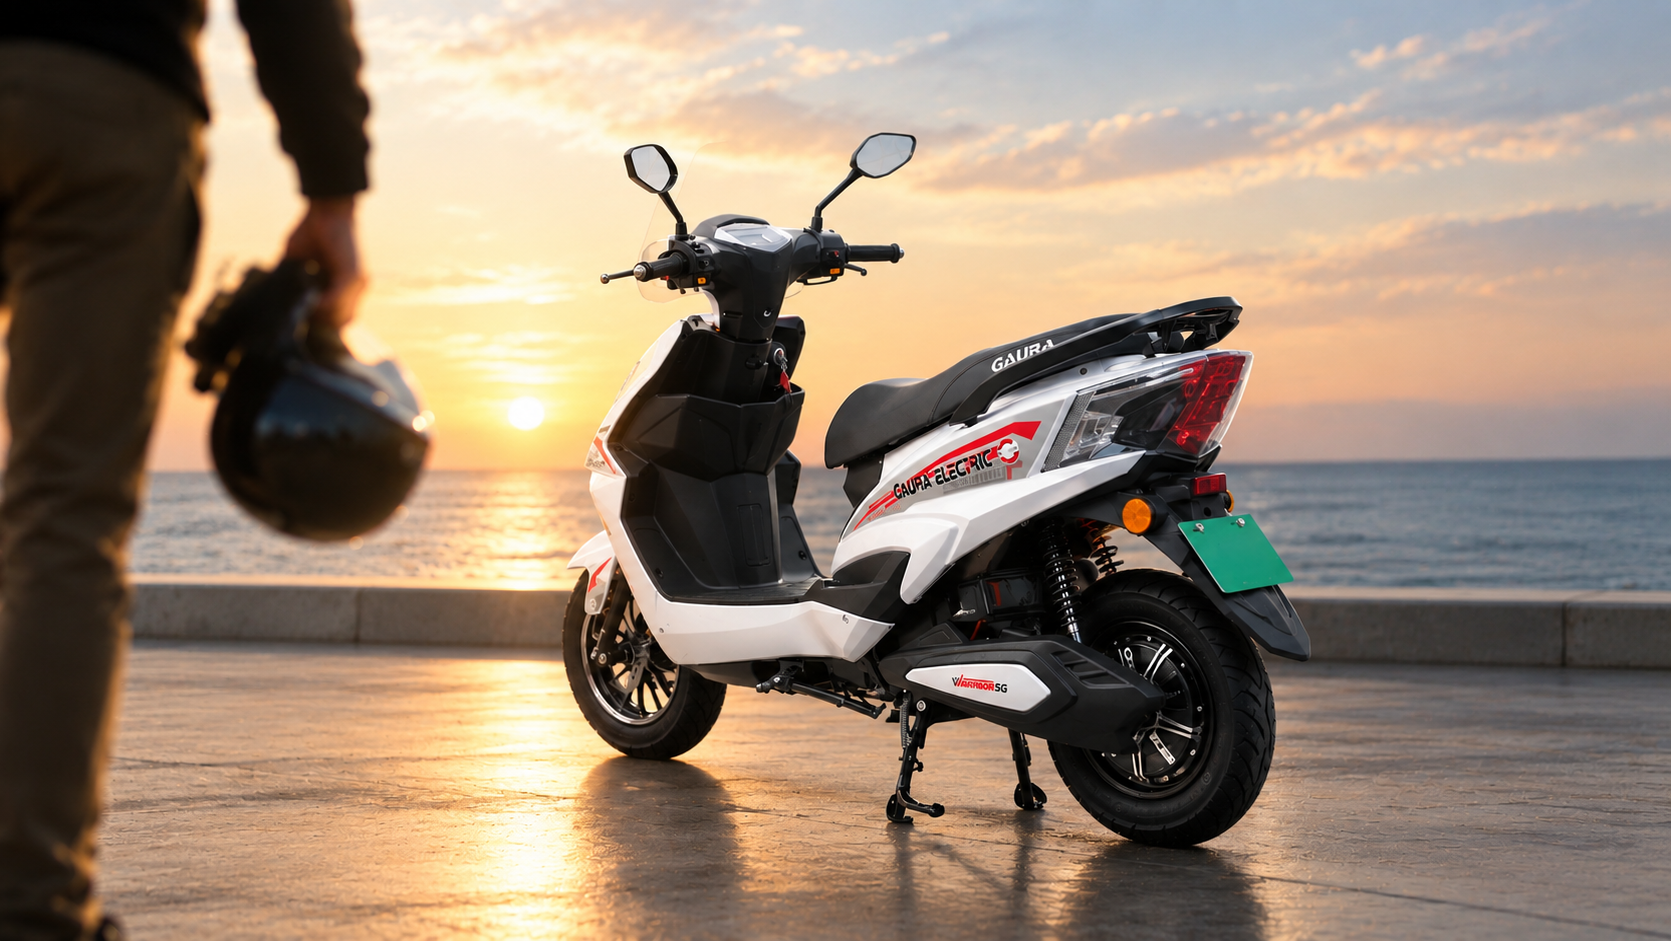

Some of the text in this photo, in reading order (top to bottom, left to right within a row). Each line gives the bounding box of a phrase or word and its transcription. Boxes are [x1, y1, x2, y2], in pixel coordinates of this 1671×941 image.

[991, 339, 1054, 372] GAURA
[893, 449, 993, 499] GAURA ELECTRIC
